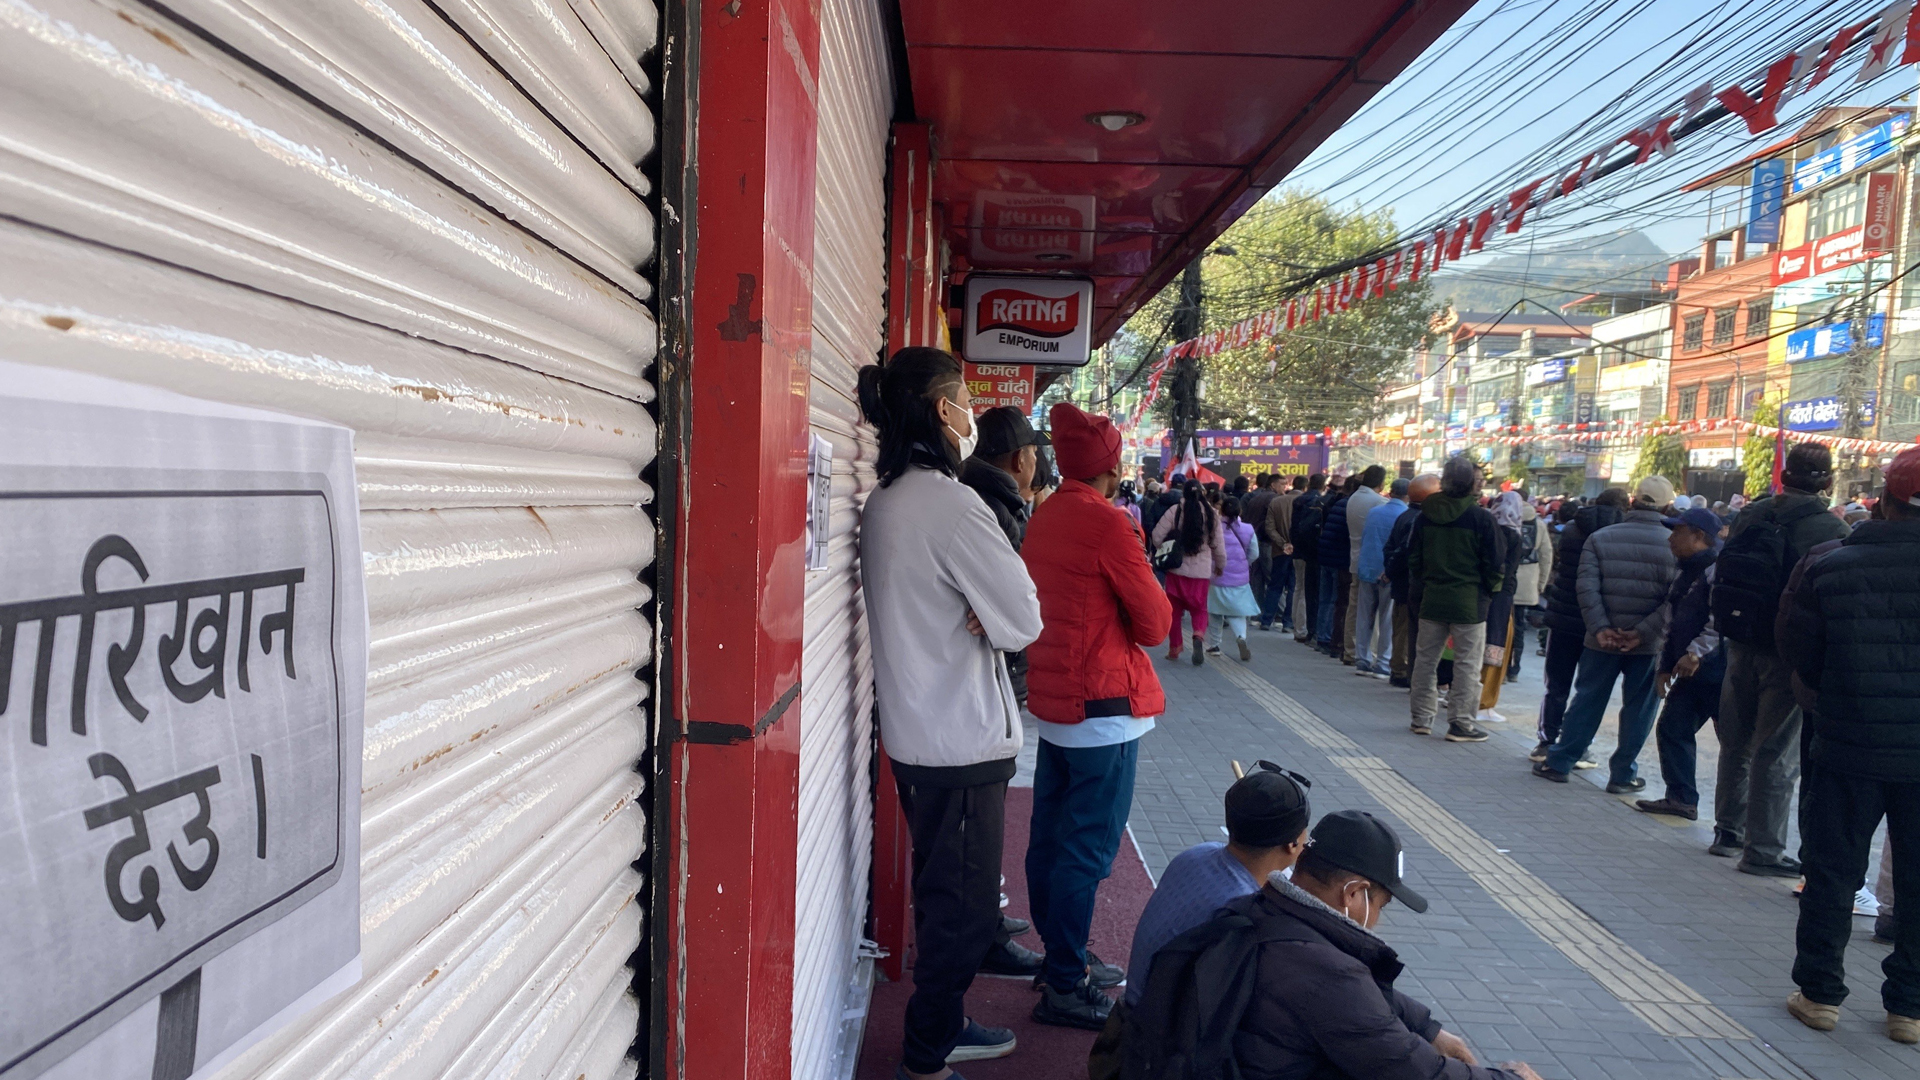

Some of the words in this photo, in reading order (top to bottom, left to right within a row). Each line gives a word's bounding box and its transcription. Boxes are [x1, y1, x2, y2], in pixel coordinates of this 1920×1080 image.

[992, 298, 1067, 323] RATNA
[999, 333, 1059, 352] EMPORIUM
[977, 365, 1020, 377] कमल
[966, 380, 992, 395] सुन
[997, 379, 1031, 394] चाँदी
[1240, 459, 1273, 475] न्देश
[1277, 463, 1310, 475] सभा
